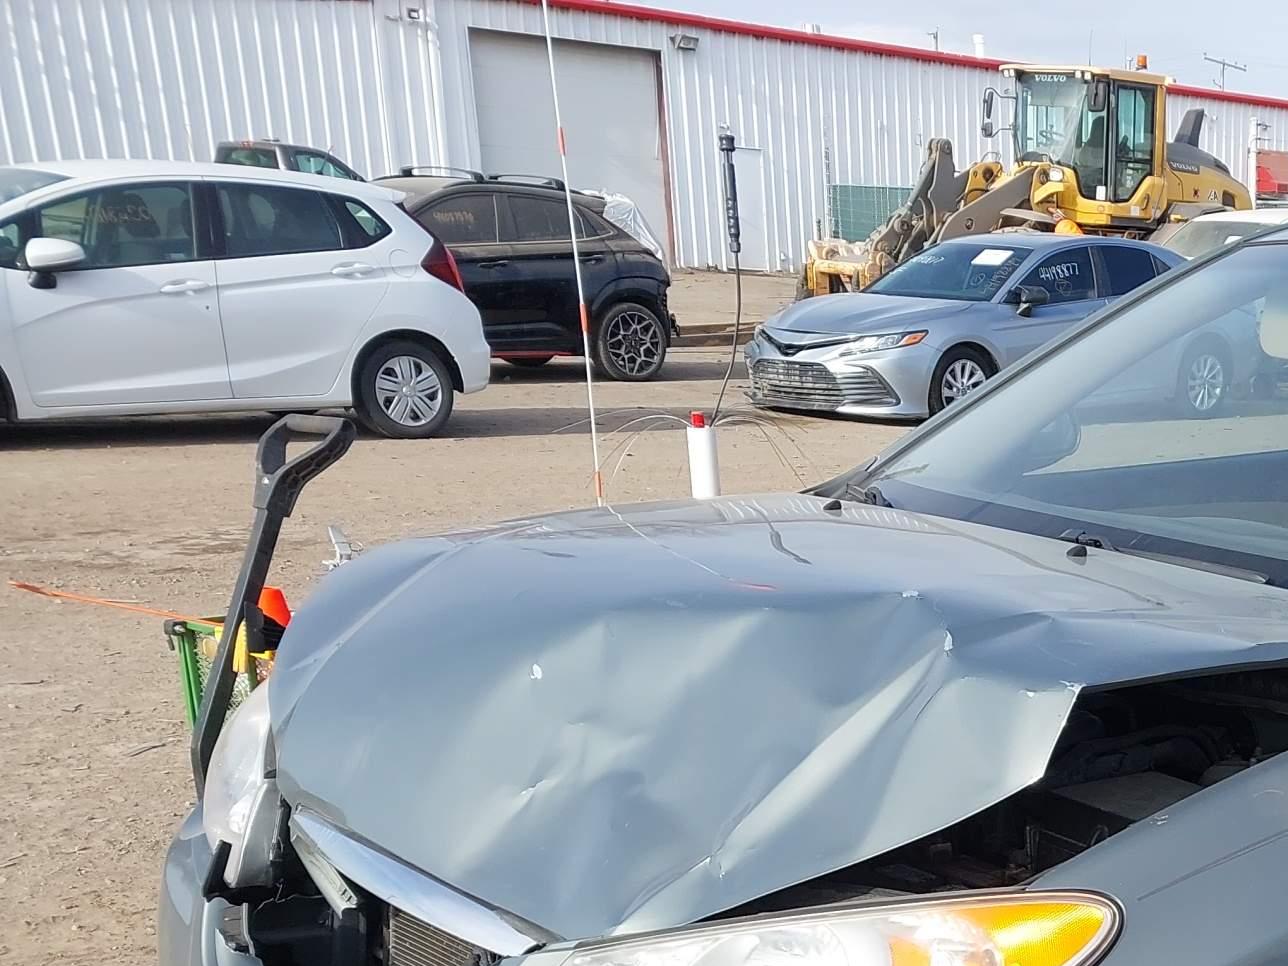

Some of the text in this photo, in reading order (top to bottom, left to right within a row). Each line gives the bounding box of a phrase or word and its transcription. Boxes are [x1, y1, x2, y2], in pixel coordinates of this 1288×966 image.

[1034, 74, 1066, 82] VOLVO
[1170, 162, 1199, 172] VOLVO
[1039, 263, 1079, 280] 44198877
